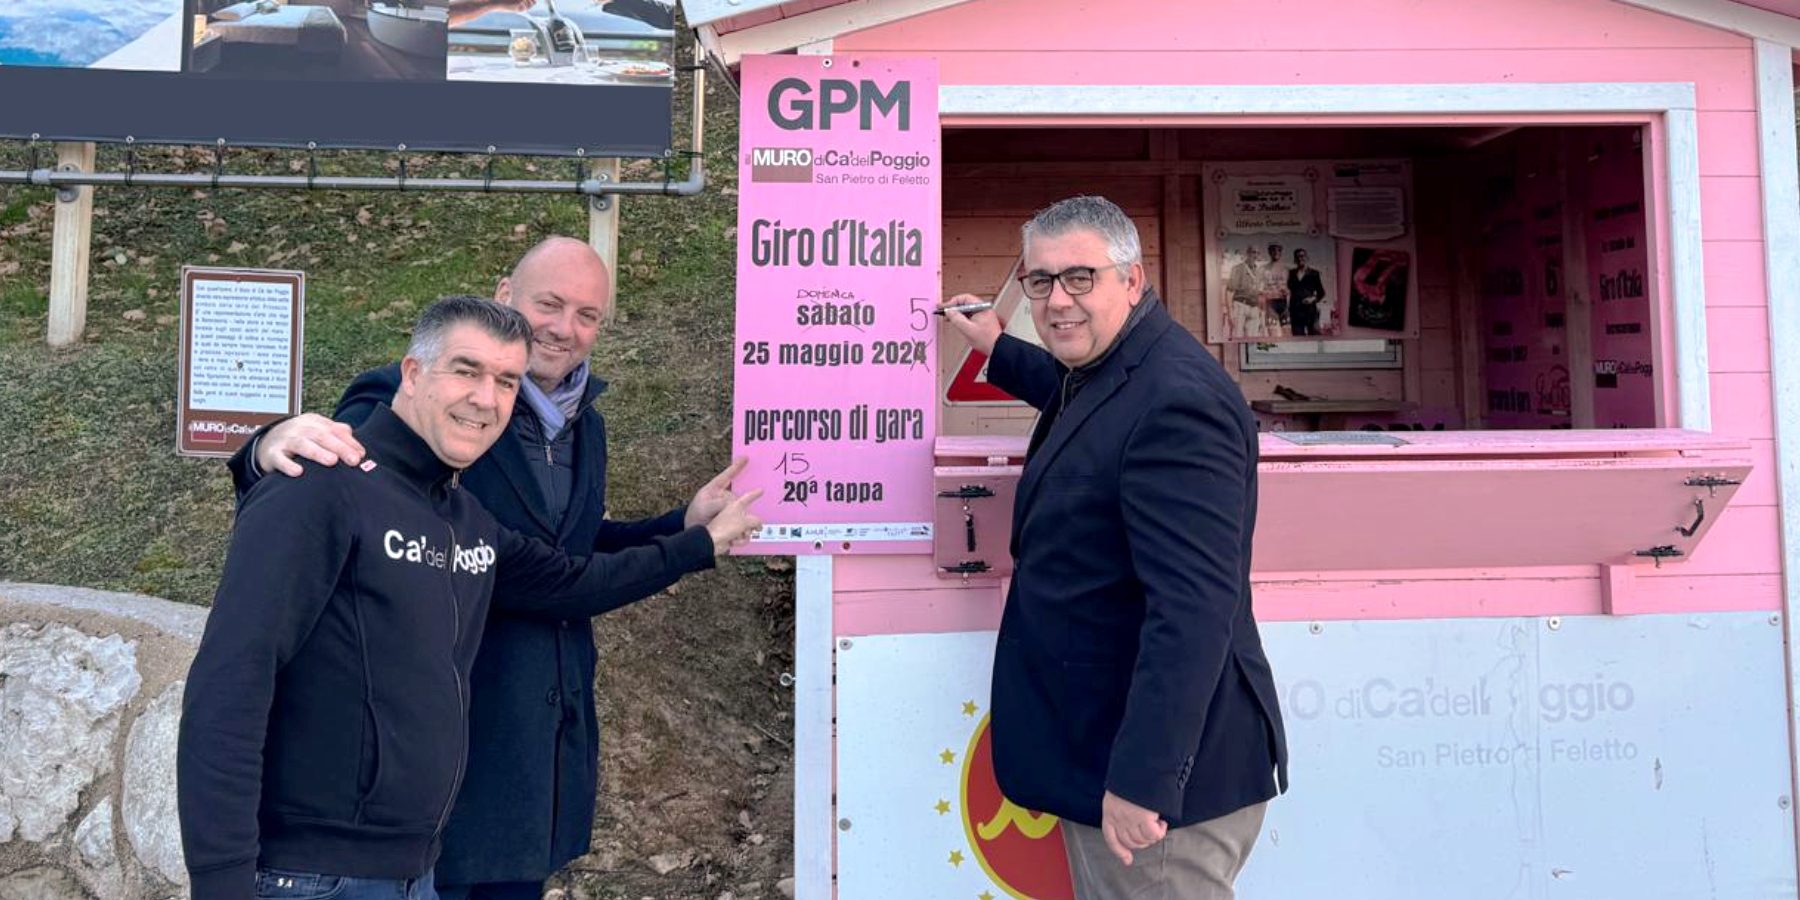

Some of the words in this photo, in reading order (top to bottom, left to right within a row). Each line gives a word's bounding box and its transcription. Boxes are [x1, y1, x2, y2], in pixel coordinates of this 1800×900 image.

[767, 77, 911, 131] GPM
[753, 149, 812, 166] MURO
[815, 173, 839, 184] San
[841, 174, 875, 184] Pietro
[878, 174, 889, 184] di
[891, 175, 931, 185] Feletto
[751, 219, 815, 267] Giro
[821, 219, 923, 267] d'Italia
[796, 302, 876, 326] sabato
[909, 297, 930, 332] 5
[742, 341, 770, 365] 25
[778, 341, 864, 367] maggio
[744, 408, 842, 446] percorso
[849, 404, 869, 440] di
[875, 408, 924, 443] gara
[773, 451, 811, 476] 15
[825, 480, 884, 503] tappa
[1377, 745, 1426, 770] San
[1435, 743, 1511, 768] Pietro
[1550, 737, 1639, 763] Feletto
